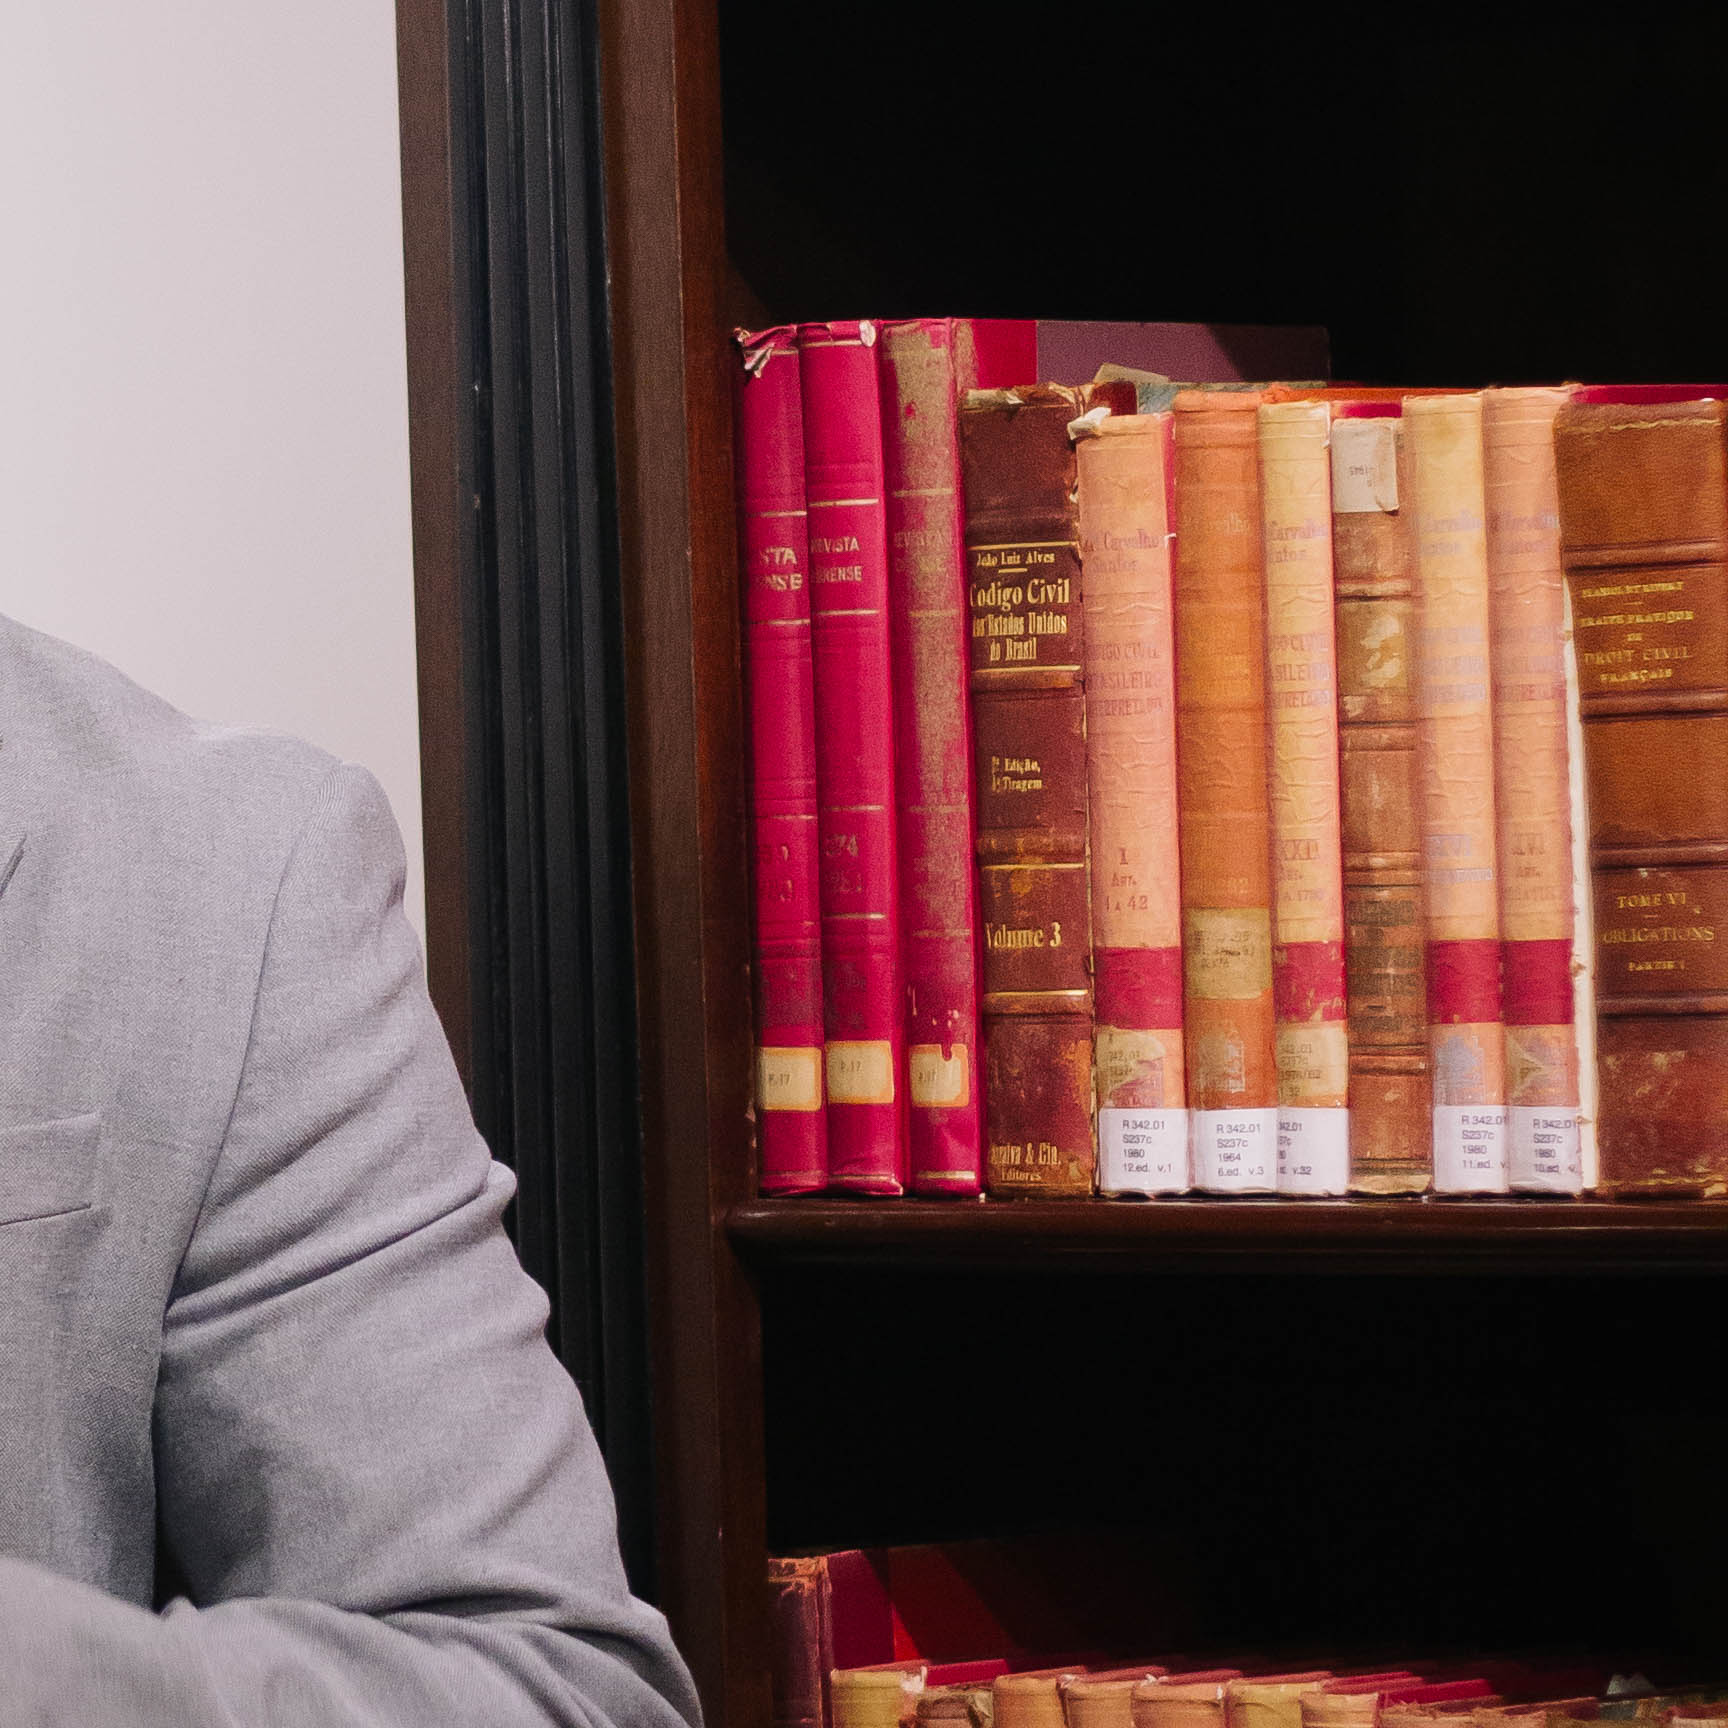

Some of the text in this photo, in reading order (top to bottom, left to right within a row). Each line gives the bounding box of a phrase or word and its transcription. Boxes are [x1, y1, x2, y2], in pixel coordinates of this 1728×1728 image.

[1001, 551, 1021, 565] Luiz
[1025, 550, 1055, 565] Alves
[1027, 578, 1070, 605] Civil
[1028, 611, 1067, 634] Unidos
[990, 637, 1037, 661] do Brasil
[1583, 650, 1635, 665] DROIT
[1616, 893, 1663, 909] TOME
[985, 921, 1062, 949] Volume 3
[1602, 926, 1716, 944] OBLIGATIONS
[1122, 1119, 1165, 1130] R 342.01
[1461, 1115, 1470, 1125] R
[1533, 1118, 1540, 1129] R
[1217, 1123, 1261, 1134] R 342.01
[1123, 1134, 1152, 1144] S237c
[1462, 1130, 1495, 1140] S237c
[1533, 1133, 1563, 1144] S237c
[1217, 1138, 1248, 1148] S237c
[1025, 1141, 1035, 1166] &
[1038, 1141, 1062, 1166] Cia.
[1123, 1149, 1145, 1159] 1980
[1123, 1162, 1172, 1173] 12.ed. v.1
[1248, 1166, 1264, 1176] v.3
